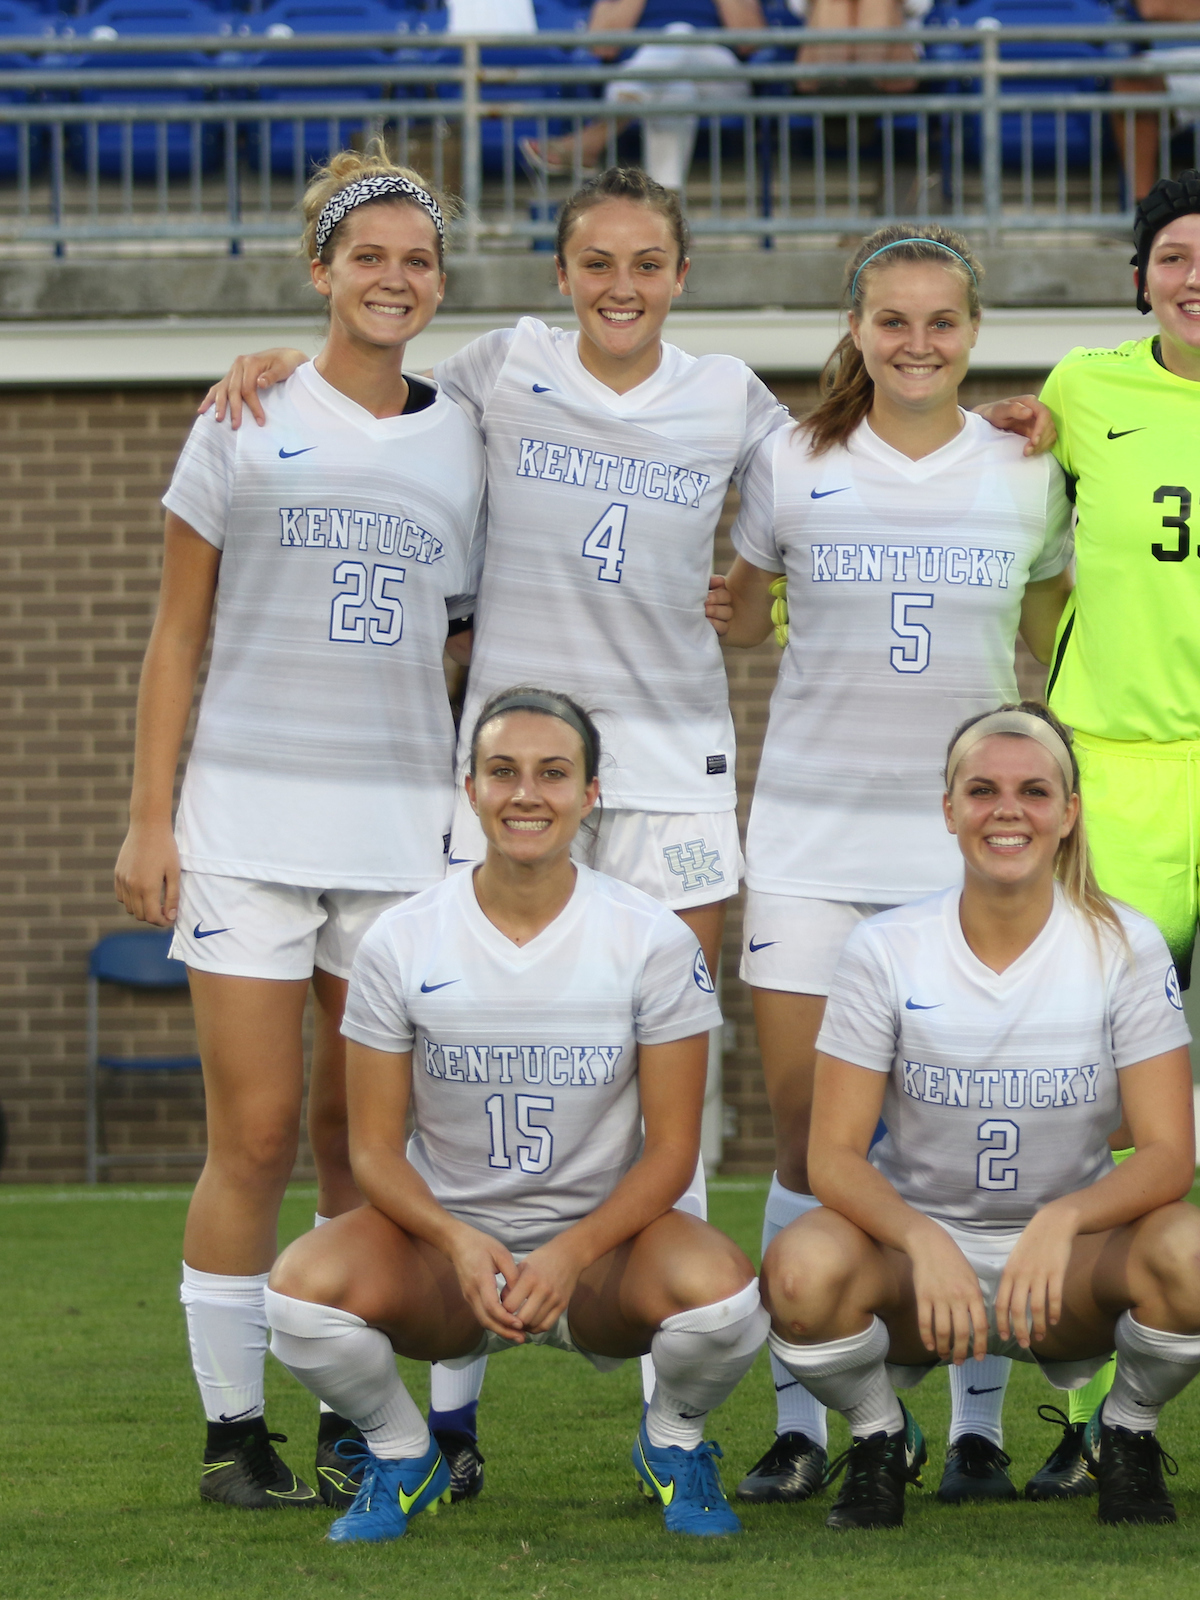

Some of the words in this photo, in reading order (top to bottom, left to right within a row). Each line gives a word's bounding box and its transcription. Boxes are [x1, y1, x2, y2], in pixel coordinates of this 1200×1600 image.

[517, 438, 710, 508] KENTUCKY
[581, 502, 628, 584] 4
[810, 543, 1016, 588] KENTUCKY
[329, 560, 406, 646] 25
[889, 592, 934, 674] 5
[663, 837, 726, 892] UK
[422, 1036, 623, 1087] KENTUCKY
[902, 1059, 1101, 1108] KENTUCKY
[484, 1093, 555, 1176] 15
[976, 1118, 1020, 1192] 2
